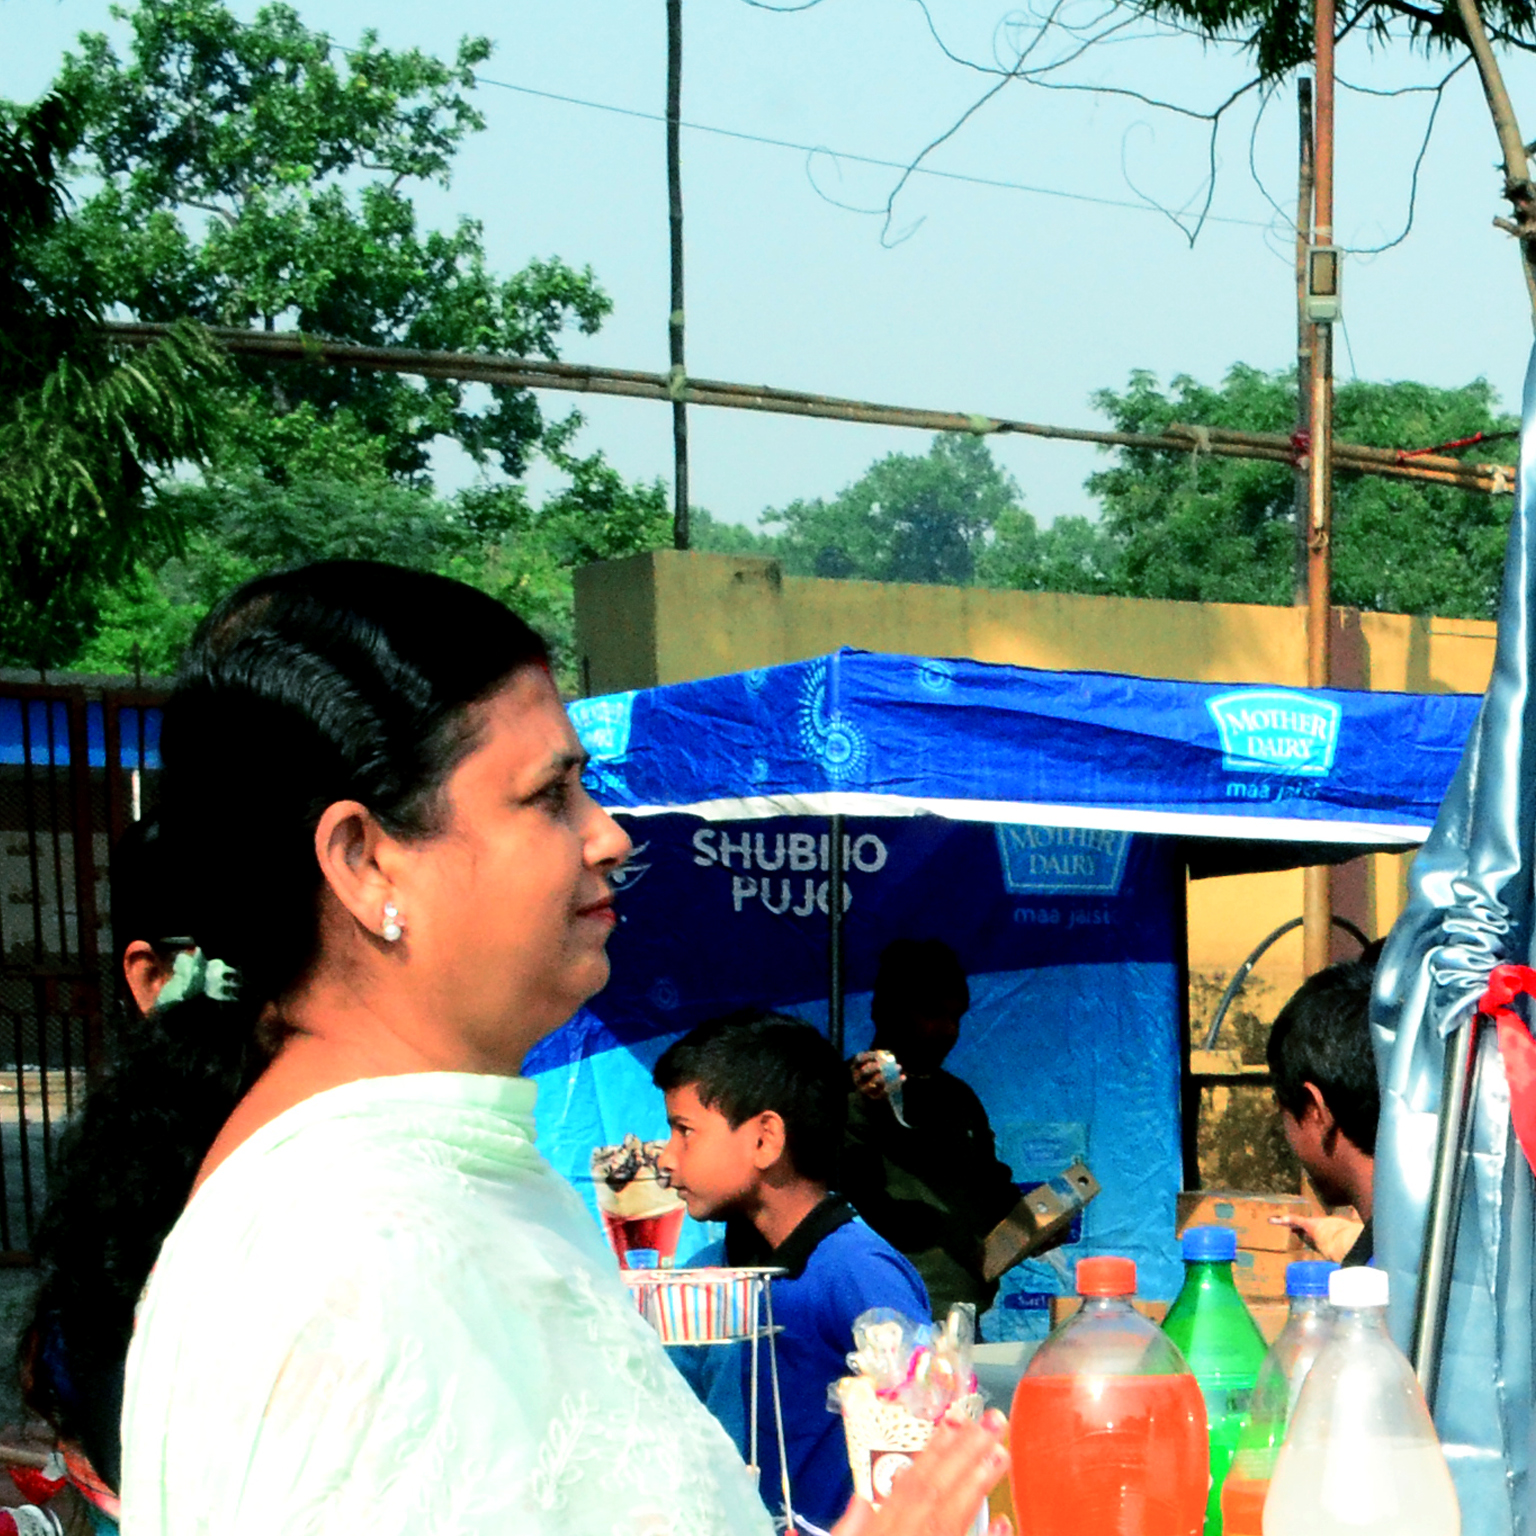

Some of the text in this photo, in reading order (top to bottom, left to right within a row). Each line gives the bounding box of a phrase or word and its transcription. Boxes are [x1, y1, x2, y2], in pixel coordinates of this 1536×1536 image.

[1225, 709, 1327, 740] MOTHER
[1248, 736, 1314, 758] DAIRY
[1226, 782, 1270, 799] maa
[1007, 826, 1114, 856] MOTHER
[1030, 853, 1096, 876] DAIRY
[731, 876, 853, 917] PUJO
[1013, 903, 1111, 929] maa jaisi
